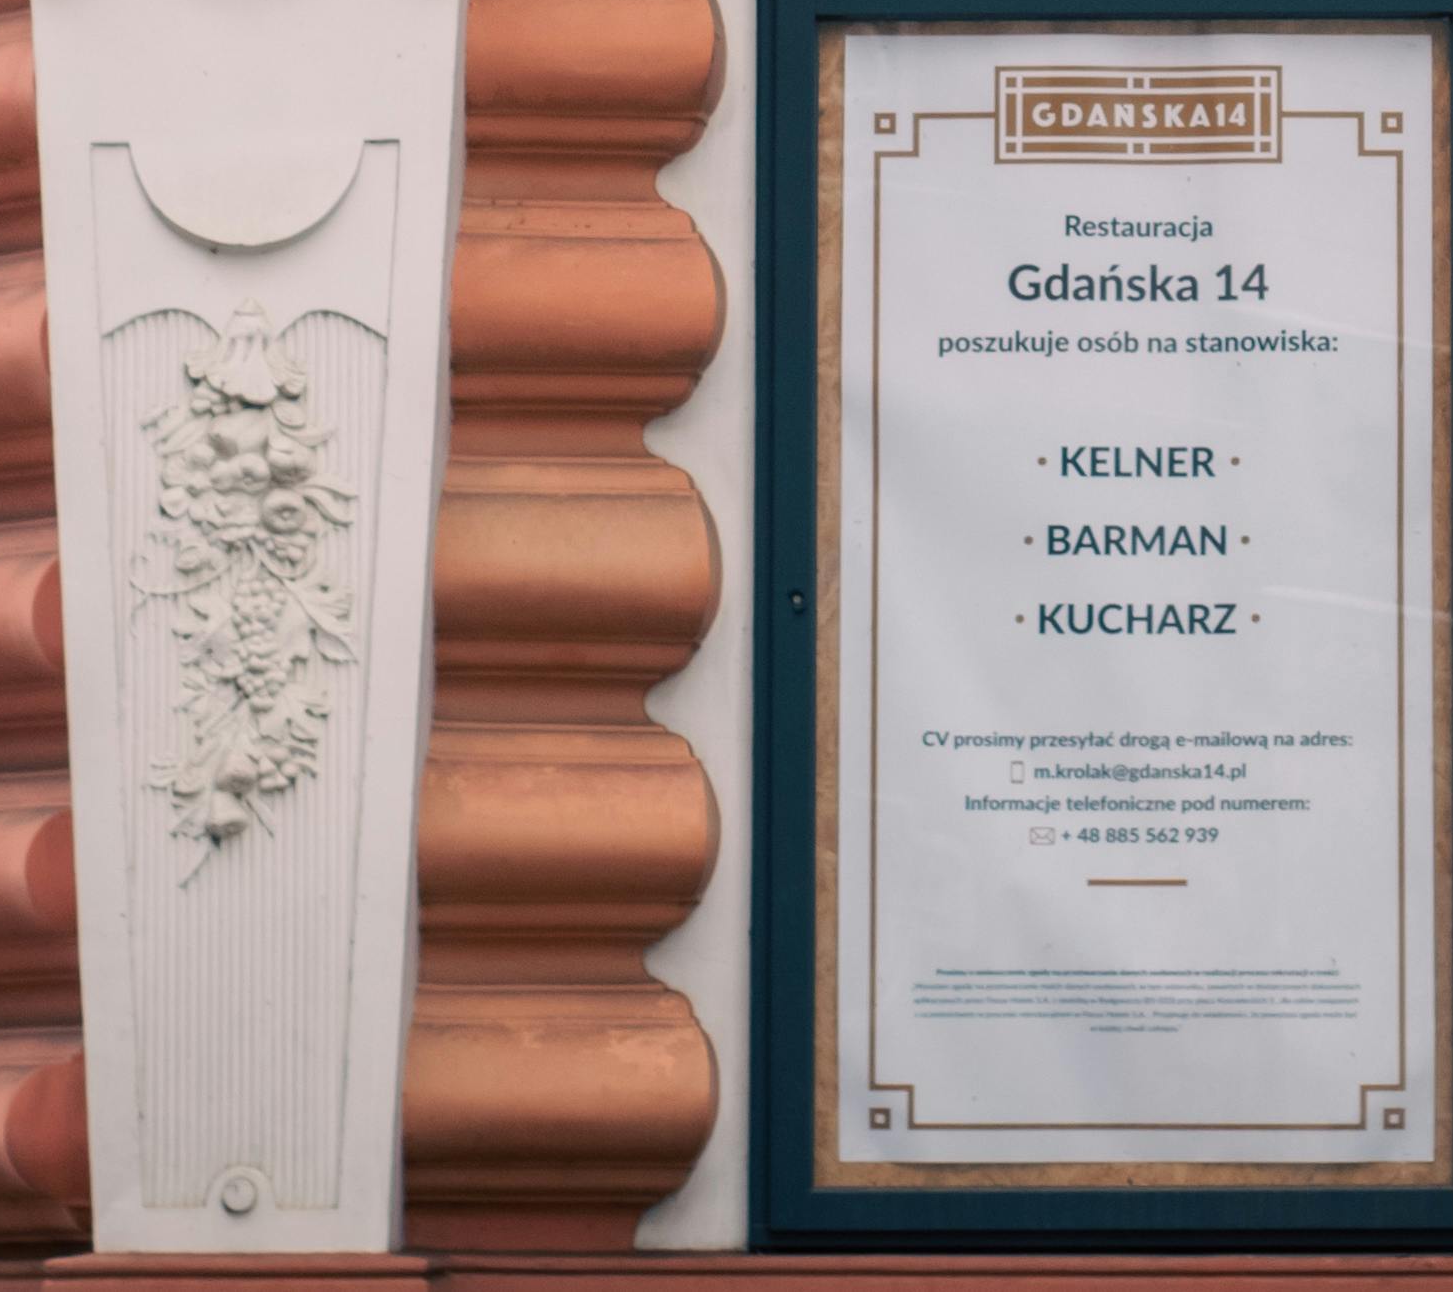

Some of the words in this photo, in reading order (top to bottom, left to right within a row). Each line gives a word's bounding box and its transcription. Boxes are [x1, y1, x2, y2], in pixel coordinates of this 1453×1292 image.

[1064, 214, 1214, 243] Restauracja
[1007, 263, 1199, 302] Gdańska
[1215, 263, 1269, 302] 14
[938, 329, 1070, 358] poszukuje
[1076, 330, 1140, 354] osób
[1147, 336, 1178, 354] na
[1185, 329, 1338, 354] stanowiska:
[1061, 446, 1216, 478] KELNER
[1047, 524, 1227, 556] BARMAN
[1038, 603, 1237, 635] KUCHARZ
[921, 730, 950, 748] CV
[953, 732, 1026, 750] prosimy
[1029, 731, 1114, 751] przesyłać
[1118, 731, 1171, 751] drogą
[1174, 731, 1269, 750] e-mailową
[1273, 734, 1295, 747] na
[1299, 730, 1353, 747] adres:
[964, 794, 1062, 815] Informacje
[1065, 795, 1177, 812] telefoniczne
[1180, 794, 1216, 815] pod
[1219, 798, 1310, 812] numerem:
[1076, 827, 1102, 844] 48
[1105, 827, 1140, 844] 885
[1145, 827, 1180, 844] 562
